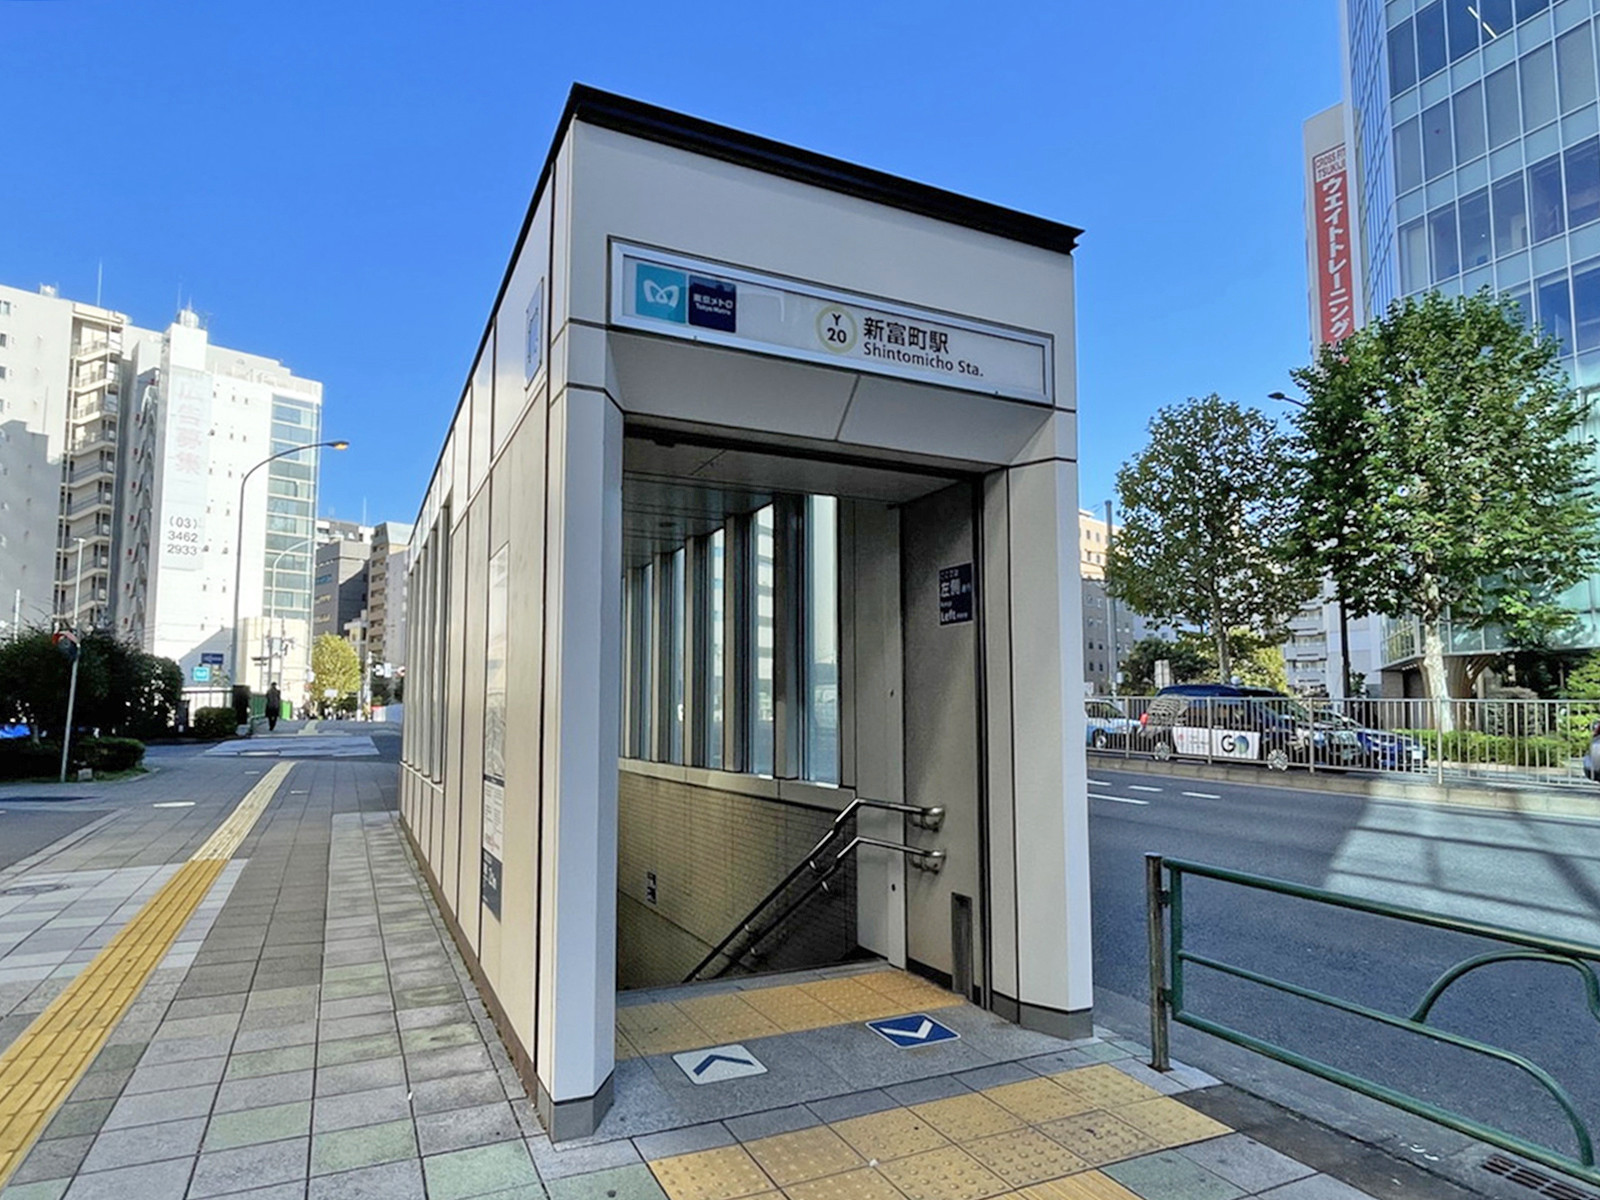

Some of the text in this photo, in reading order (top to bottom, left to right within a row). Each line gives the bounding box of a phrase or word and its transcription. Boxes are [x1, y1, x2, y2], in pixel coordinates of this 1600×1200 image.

[1322, 176, 1350, 338] ウエイトトレーニング
[832, 313, 842, 326] Y
[827, 327, 847, 344] 20
[863, 316, 949, 354] 新富町駅
[863, 341, 984, 377] Shintomicho Sta.
[169, 515, 198, 530] (03)
[168, 530, 199, 543] 3462
[167, 543, 198, 556] 2933
